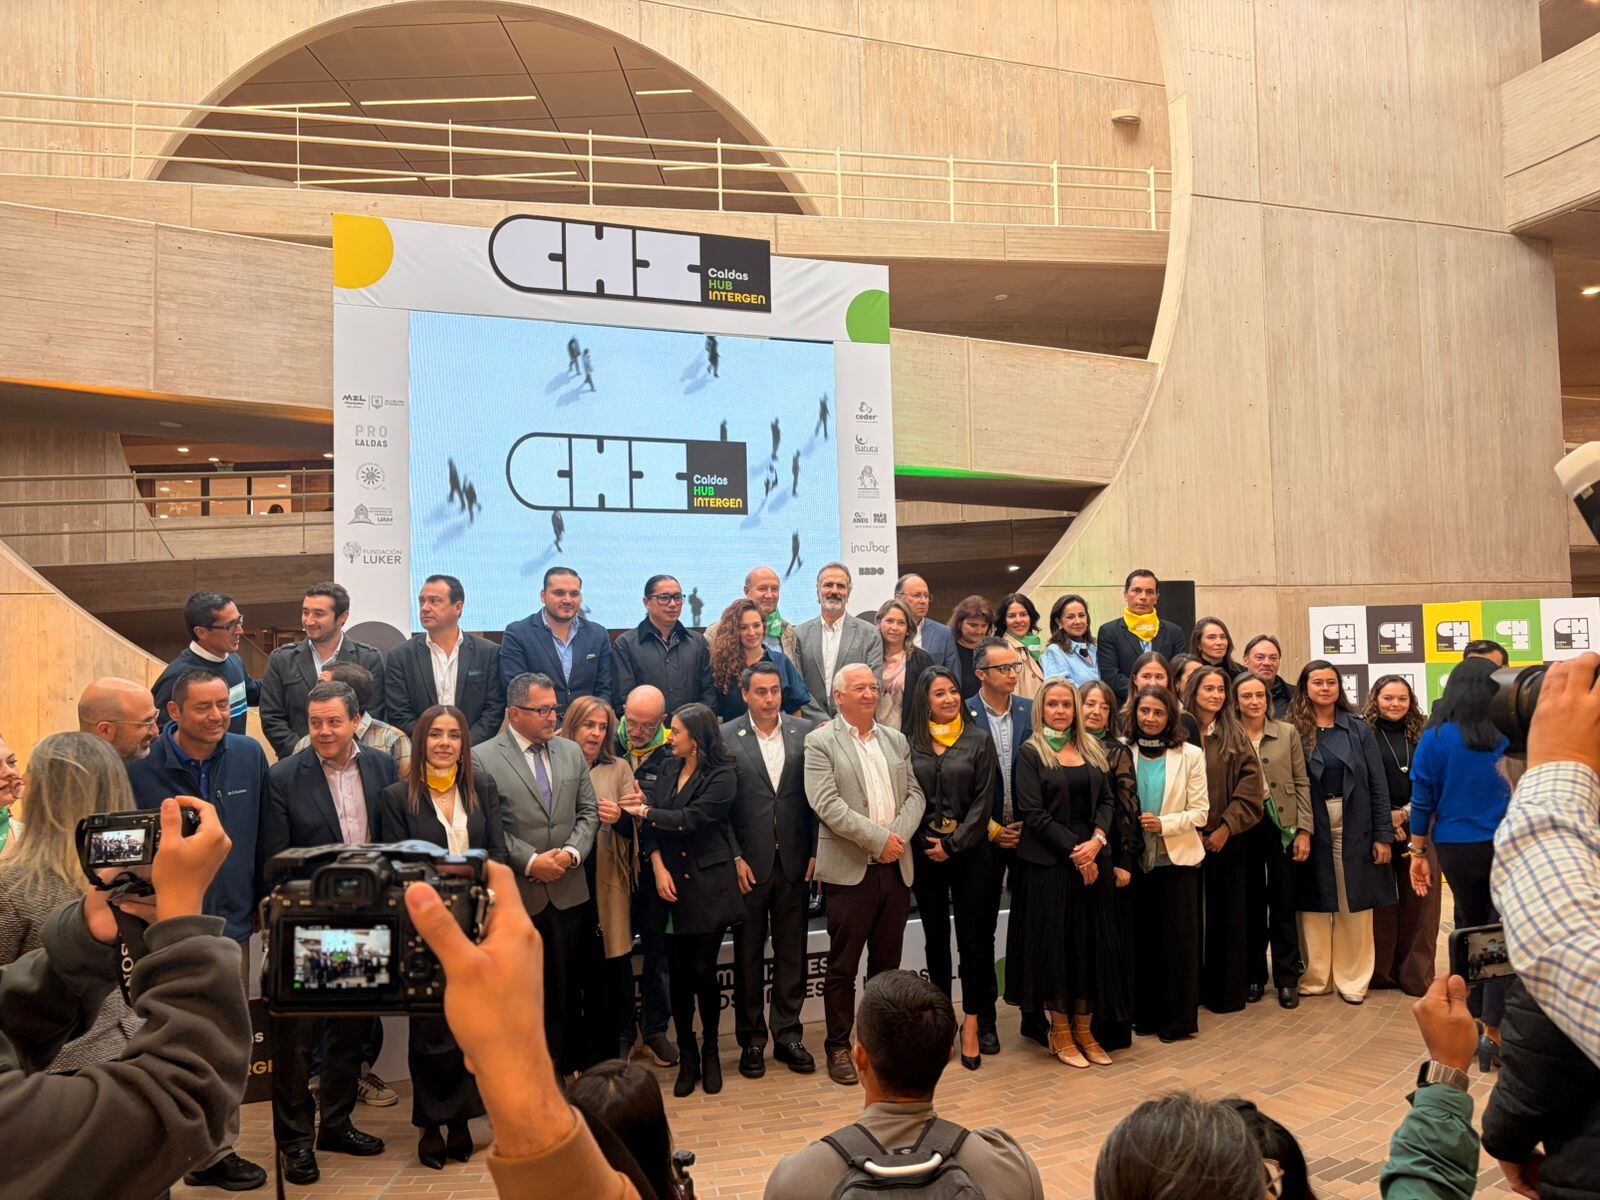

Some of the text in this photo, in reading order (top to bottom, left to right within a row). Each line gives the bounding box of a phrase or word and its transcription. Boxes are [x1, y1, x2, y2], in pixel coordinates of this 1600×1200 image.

[708, 268, 749, 281] Caldas
[708, 279, 733, 290] HUB
[708, 290, 766, 305] INTERGEN
[355, 425, 388, 438] PRO
[854, 444, 879, 453] Batuta
[693, 474, 728, 486] Caldas
[693, 486, 715, 496] HUB
[693, 497, 743, 508] INTERGEN
[850, 541, 890, 554] incubar
[363, 555, 402, 565] LUKER
[858, 567, 885, 576] BBDO
